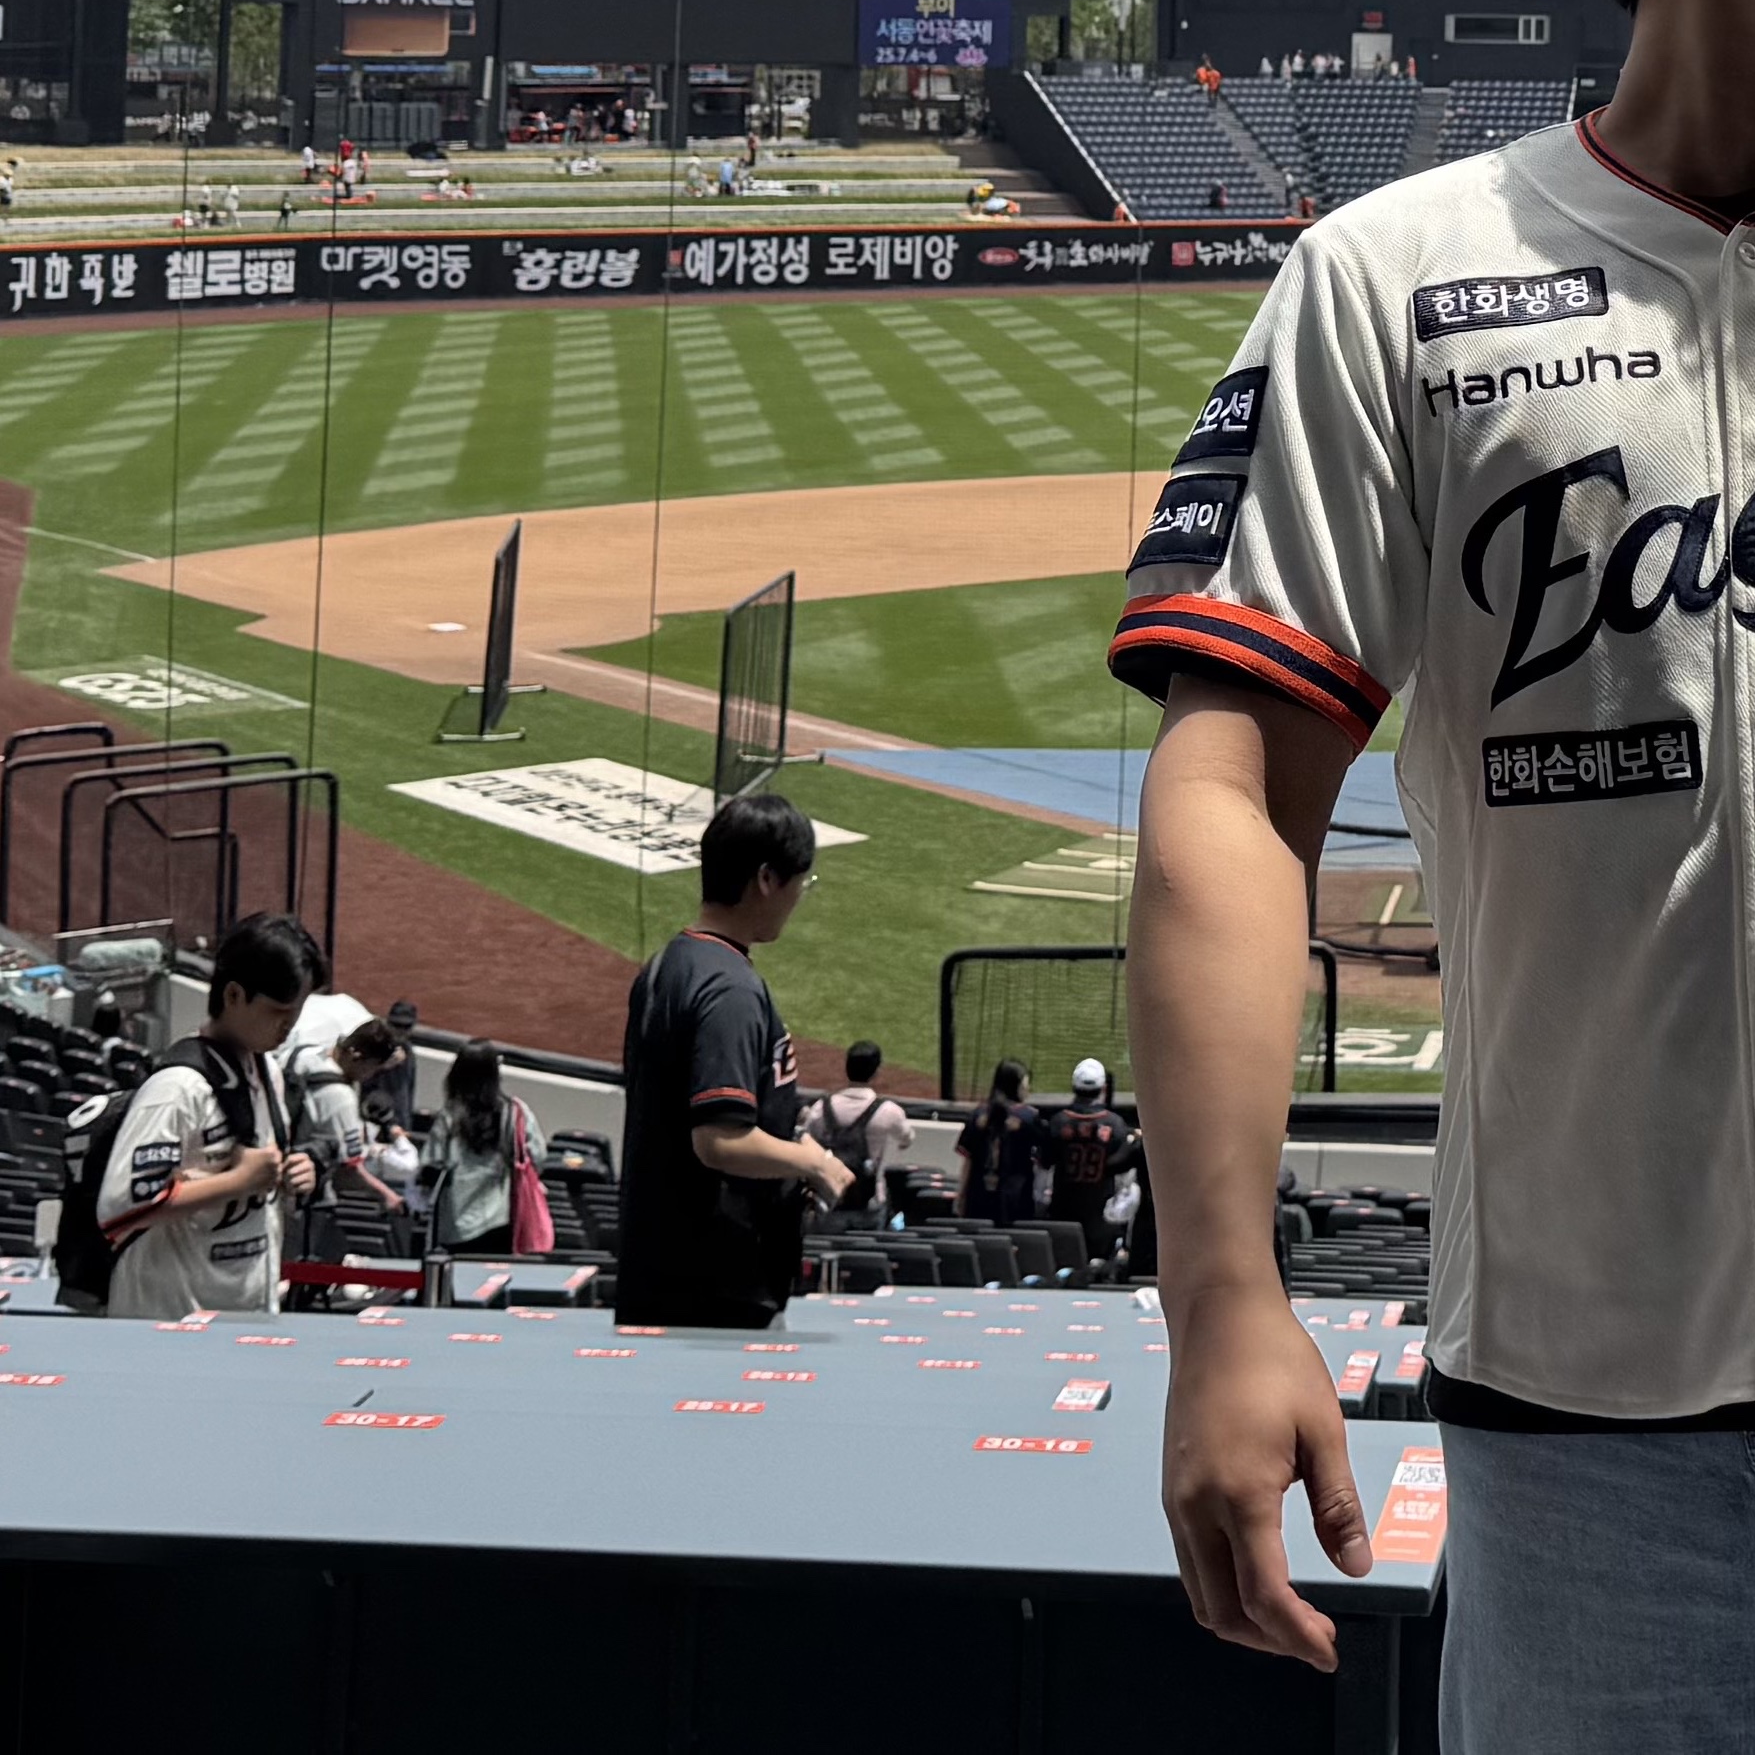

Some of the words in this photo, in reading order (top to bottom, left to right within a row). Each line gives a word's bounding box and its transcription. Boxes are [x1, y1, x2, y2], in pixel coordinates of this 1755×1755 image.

[876, 18, 993, 45] 서동연꽃축제
[9, 252, 138, 313] 귀한족발
[165, 249, 242, 301] 첼로
[244, 259, 296, 295] 병원
[513, 247, 641, 292] 홈런볼
[685, 236, 810, 286] 예가정성
[825, 234, 960, 281] 로제비앙
[1432, 274, 1592, 326] 한화생명
[1423, 346, 1662, 418] Hanwha
[1489, 731, 1694, 797] 한화손해보험
[334, 1412, 435, 1427] 30-17
[982, 1437, 1079, 1453] 30-16
